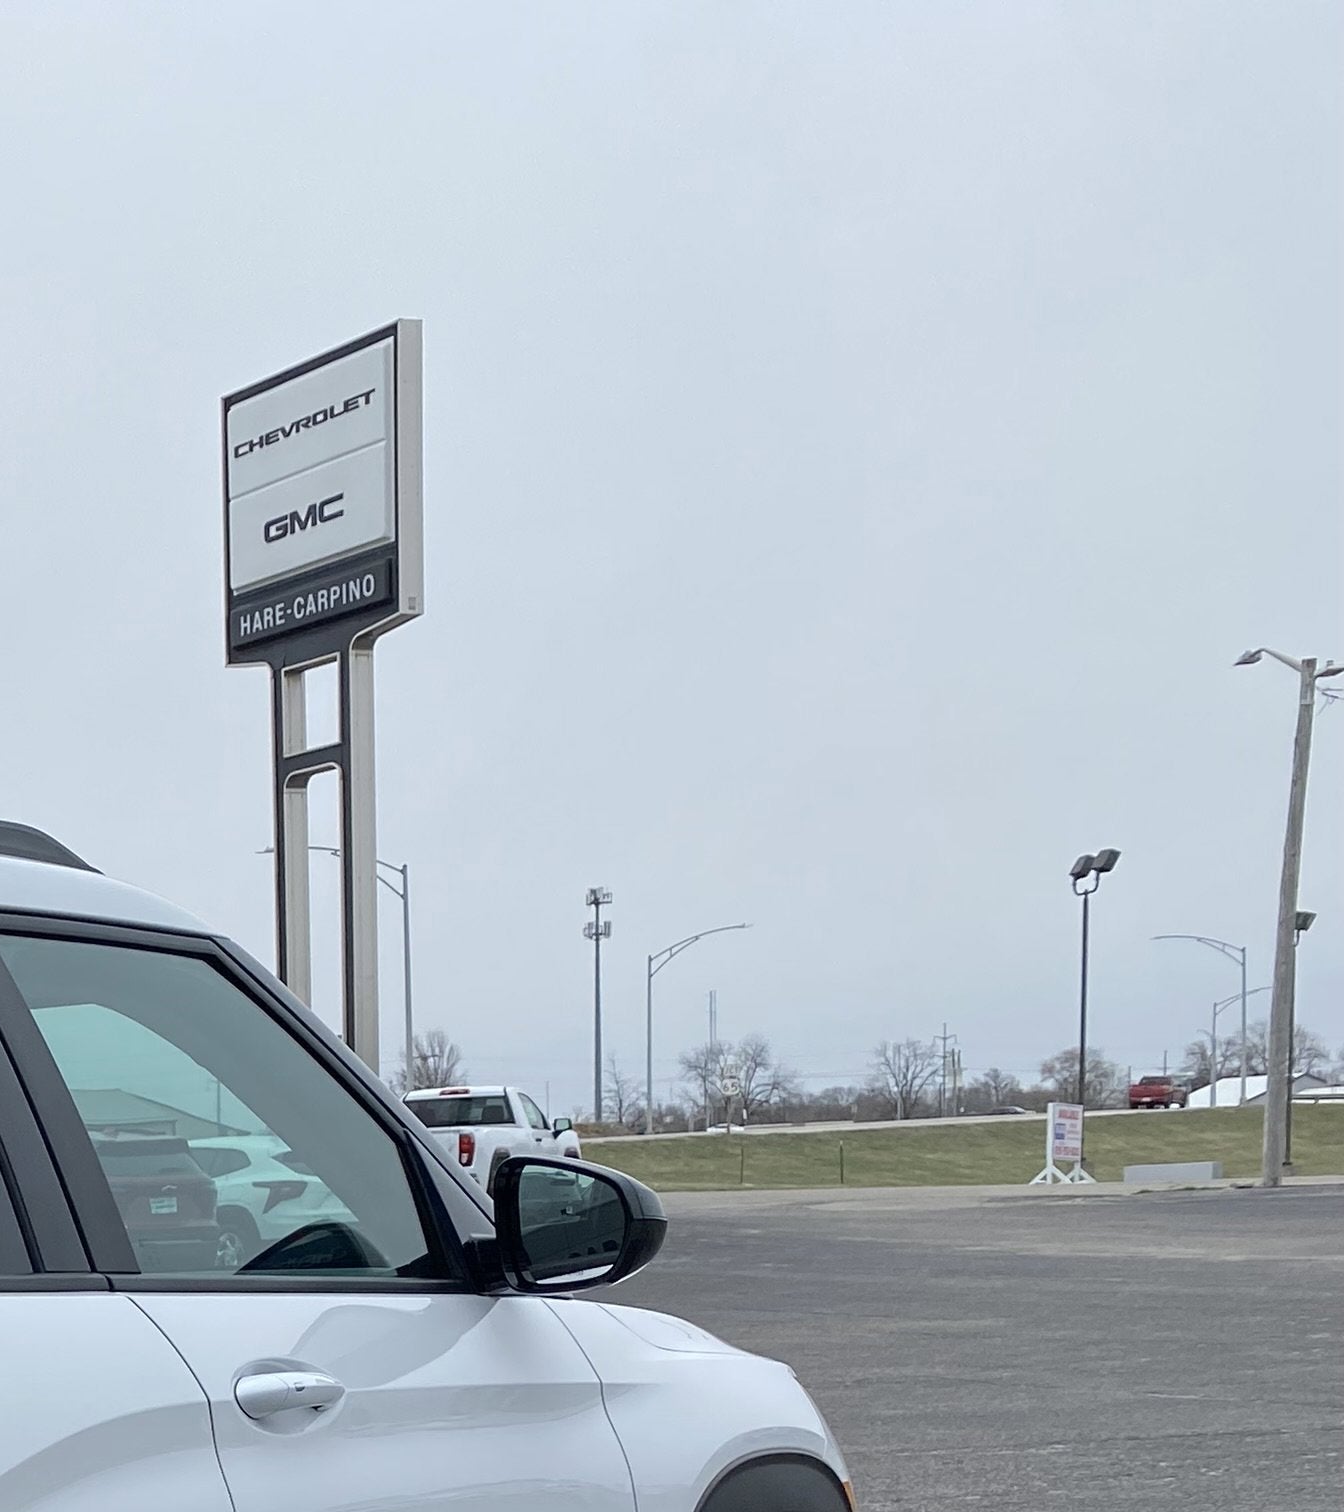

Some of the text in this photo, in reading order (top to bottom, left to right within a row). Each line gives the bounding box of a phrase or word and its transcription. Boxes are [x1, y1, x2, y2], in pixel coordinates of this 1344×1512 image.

[233, 388, 376, 459] CHEVROLET
[264, 492, 345, 544] GMC
[239, 573, 375, 637] HARE-CARPINO
